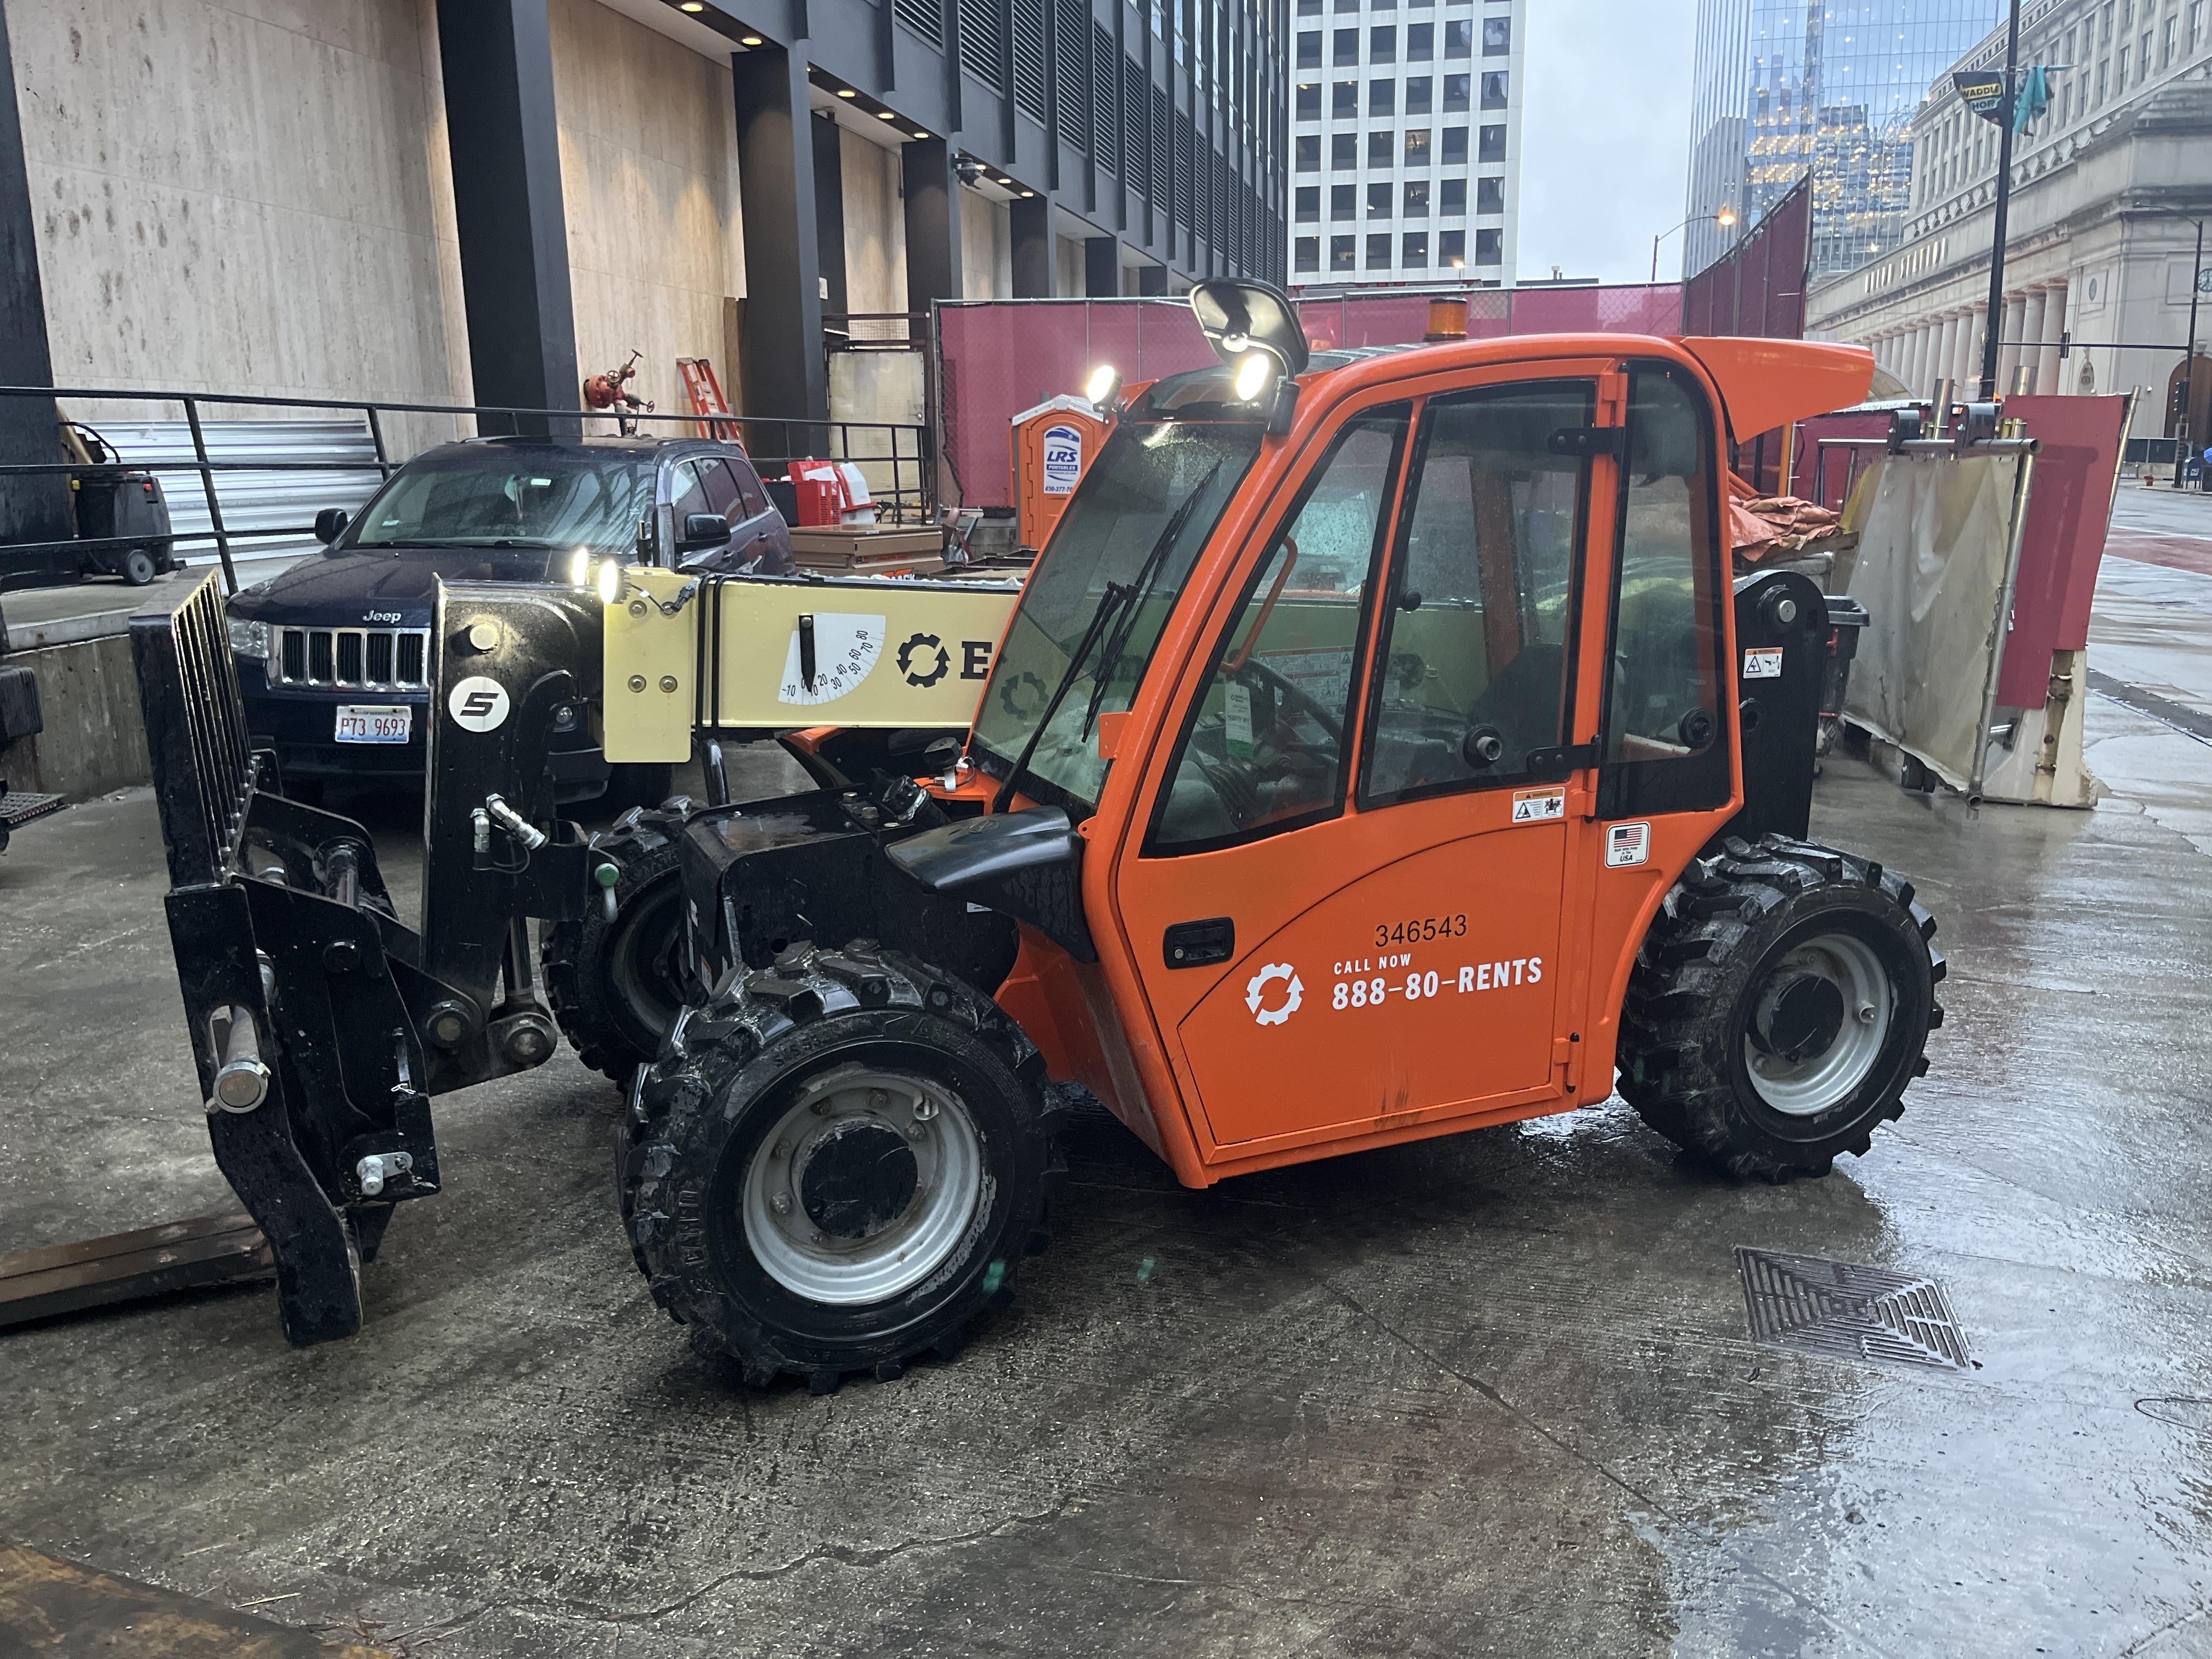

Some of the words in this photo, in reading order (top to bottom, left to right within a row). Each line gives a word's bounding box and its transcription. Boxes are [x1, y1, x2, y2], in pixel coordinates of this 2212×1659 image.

[1047, 451, 1077, 462] LRS
[363, 610, 401, 624] Jeep
[856, 630, 868, 640] 80
[860, 642, 873, 653] 70
[849, 649, 861, 660] 60
[837, 664, 848, 675] 40
[849, 663, 861, 675] 50
[818, 674, 828, 686] 20
[831, 676, 842, 690] 30
[782, 684, 796, 697] -10
[375, 718, 406, 736] 9693
[1375, 914, 1467, 947] 346543
[1334, 958, 1371, 975] CALL
[1379, 953, 1411, 969] NOW
[1332, 957, 1542, 1010] 888-80-RENTS
